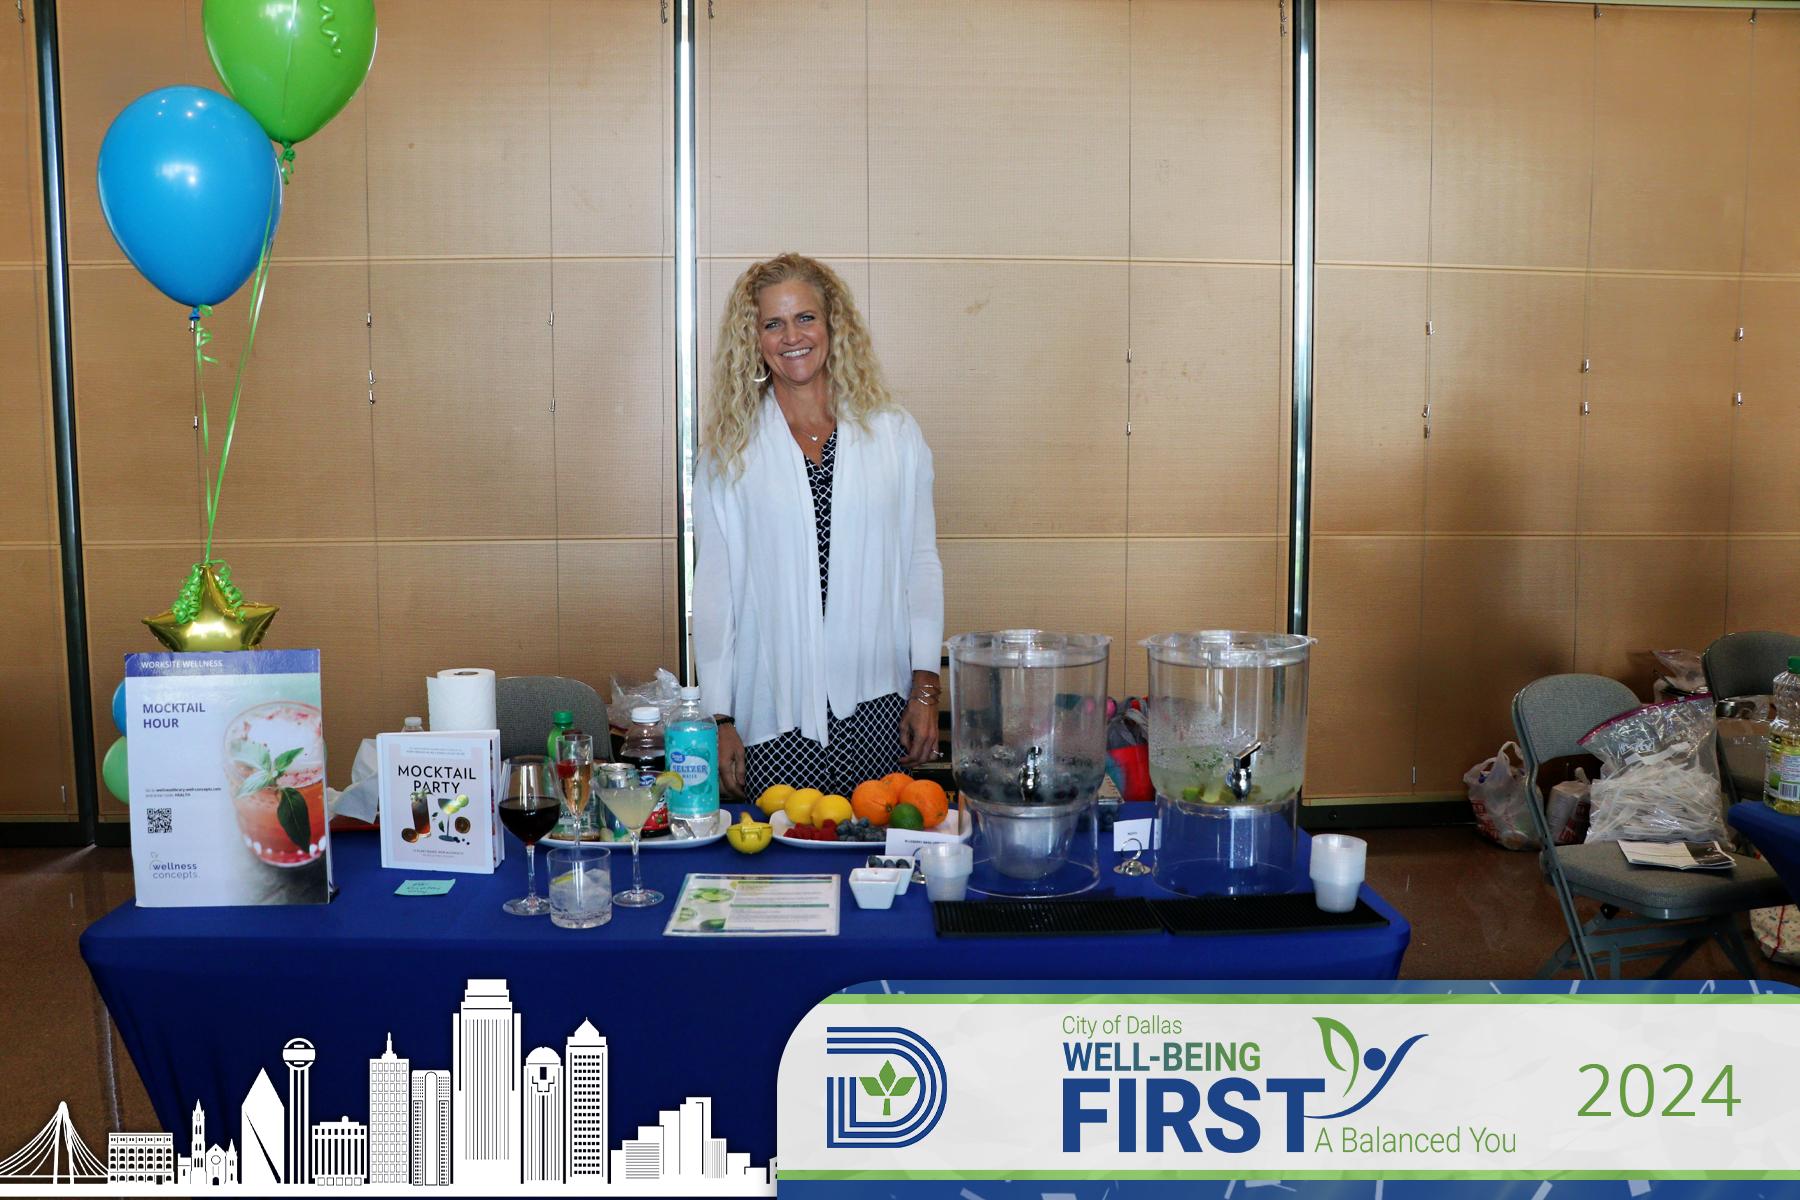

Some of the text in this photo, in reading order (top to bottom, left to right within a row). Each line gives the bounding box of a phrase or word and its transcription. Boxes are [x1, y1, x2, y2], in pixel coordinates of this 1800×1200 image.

[141, 659, 224, 669] WORKSITE WELLNESS
[143, 702, 206, 714] MOCKTAIL
[143, 718, 179, 729] HOUR
[398, 764, 477, 780] MOCKTAIL
[413, 780, 460, 795] PARTY
[152, 861, 198, 870] wellness
[152, 871, 199, 881] concepts
